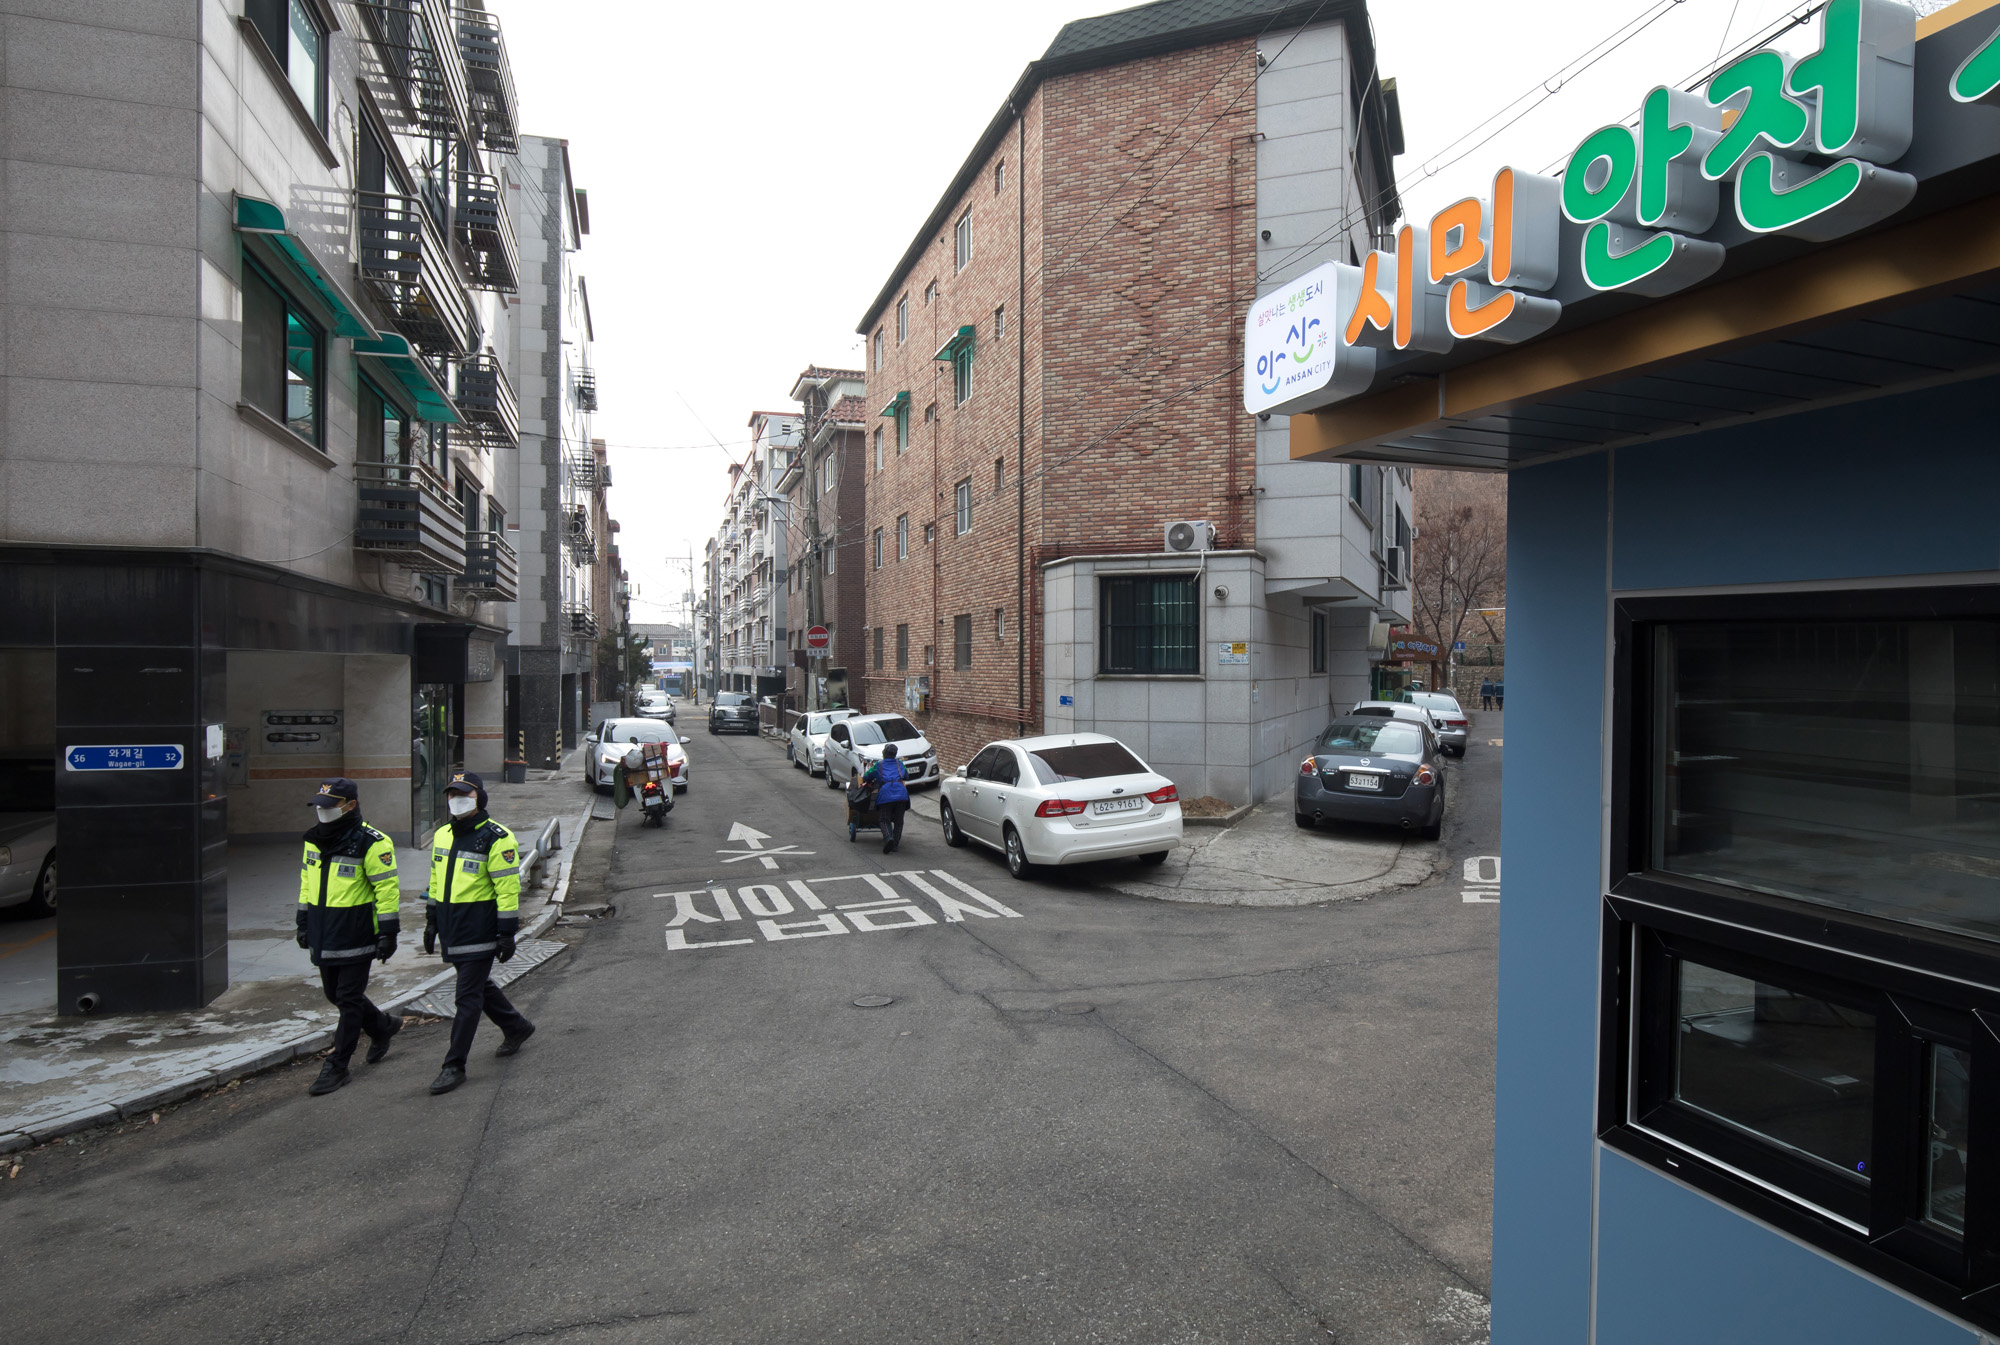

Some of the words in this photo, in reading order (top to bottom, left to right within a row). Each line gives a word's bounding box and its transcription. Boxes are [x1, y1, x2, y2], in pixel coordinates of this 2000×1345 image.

[1344, 165, 1515, 351] 시민
[1561, 0, 1861, 291] 안전
[1258, 303, 1286, 327] 살맛나는
[1287, 280, 1323, 312] 생생도시
[1257, 316, 1320, 395] 안산
[1285, 367, 1313, 386] ANSAN
[1314, 360, 1331, 374] CITY
[1408, 641, 1438, 655] 어린이집
[73, 754, 86, 763] 36
[108, 748, 143, 759] 와개길
[165, 753, 176, 761] 32
[108, 760, 145, 768] Wagae-gil
[1117, 799, 1137, 809] 9161
[652, 869, 1024, 950] 진입금지
